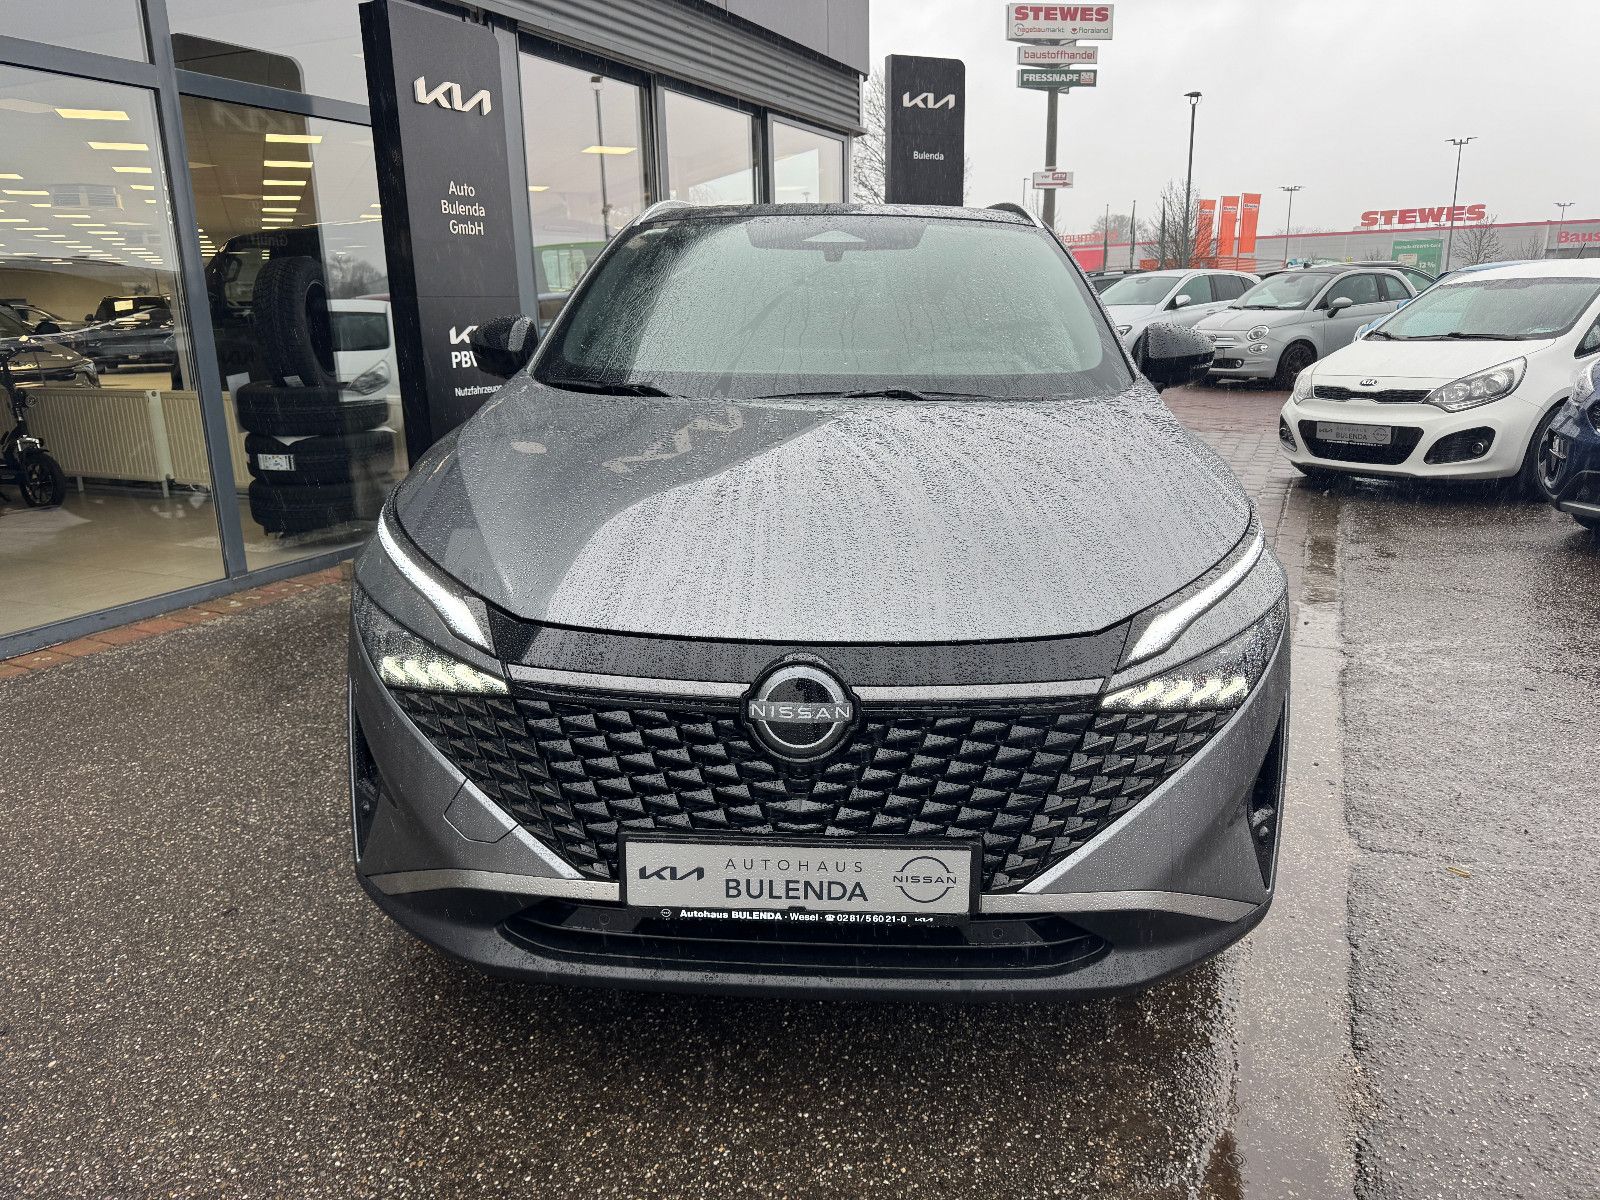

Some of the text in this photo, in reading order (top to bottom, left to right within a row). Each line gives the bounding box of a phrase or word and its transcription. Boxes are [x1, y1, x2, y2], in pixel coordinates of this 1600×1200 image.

[1014, 5, 1109, 22] STEWES
[1023, 50, 1095, 60] baustoffhandel
[1023, 73, 1080, 82] FRESSNAPF
[413, 76, 492, 116] KIA
[902, 91, 956, 110] KIA
[913, 150, 945, 161] Bulenda
[448, 180, 476, 197] Auto
[440, 199, 486, 217] Bulenda
[1360, 203, 1487, 227] STEWES
[449, 219, 485, 236] GmbH
[750, 703, 851, 719] NISSAN
[638, 865, 705, 881] KIA
[725, 858, 863, 873] AUTOHAUS
[893, 875, 957, 884] NISSAN
[725, 878, 869, 902] BULENDA
[679, 909, 729, 919] Autohaus
[731, 911, 783, 921] BULENDA
[789, 913, 818, 922] Wesel
